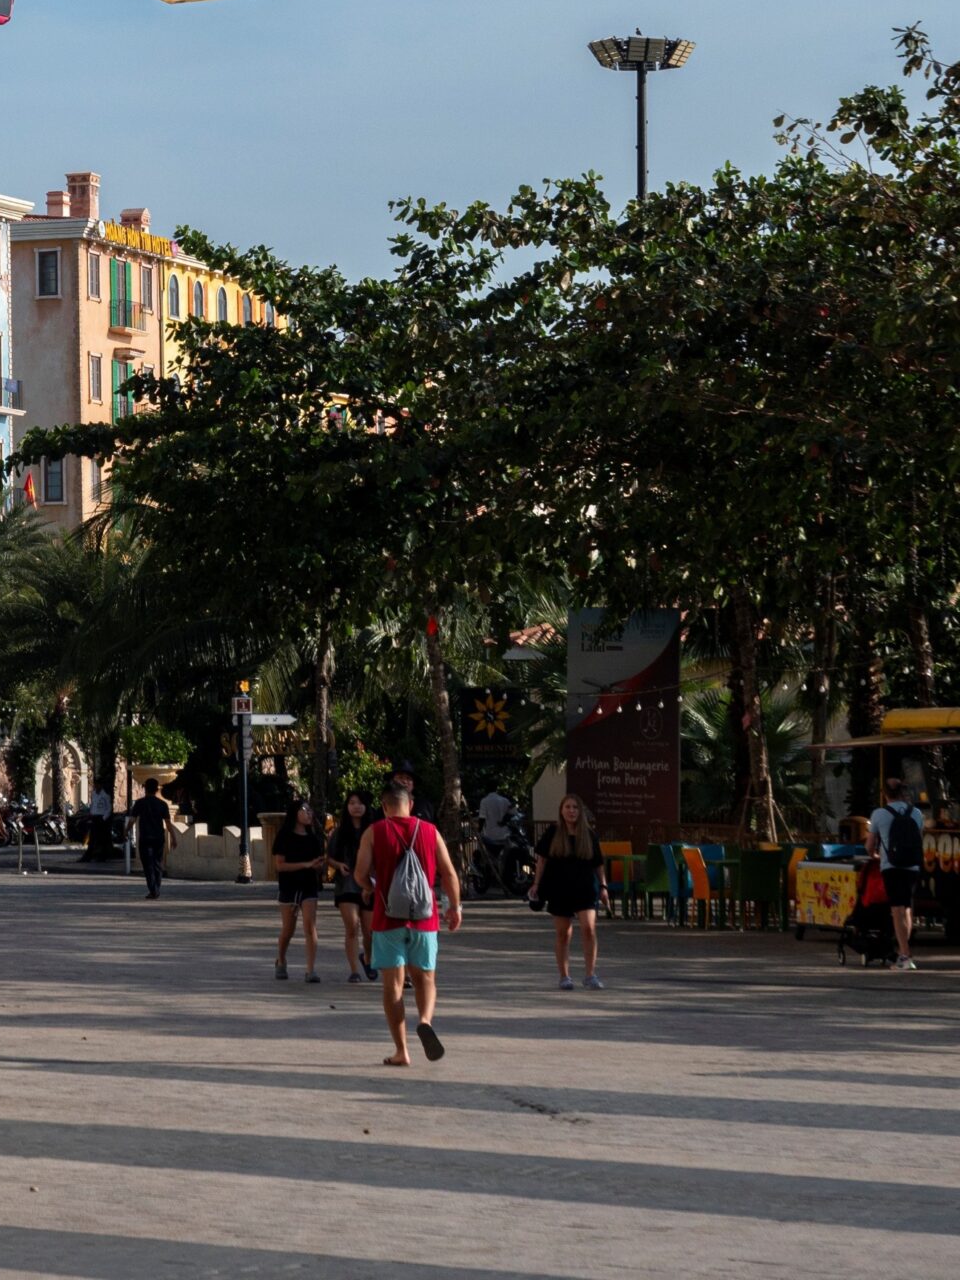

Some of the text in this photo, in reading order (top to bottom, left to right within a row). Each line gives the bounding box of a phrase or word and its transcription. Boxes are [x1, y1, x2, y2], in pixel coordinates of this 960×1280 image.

[152, 235, 172, 257] HOTEL
[575, 755, 670, 776] Artisan Boulangerie
[597, 770, 647, 790] from Paris
